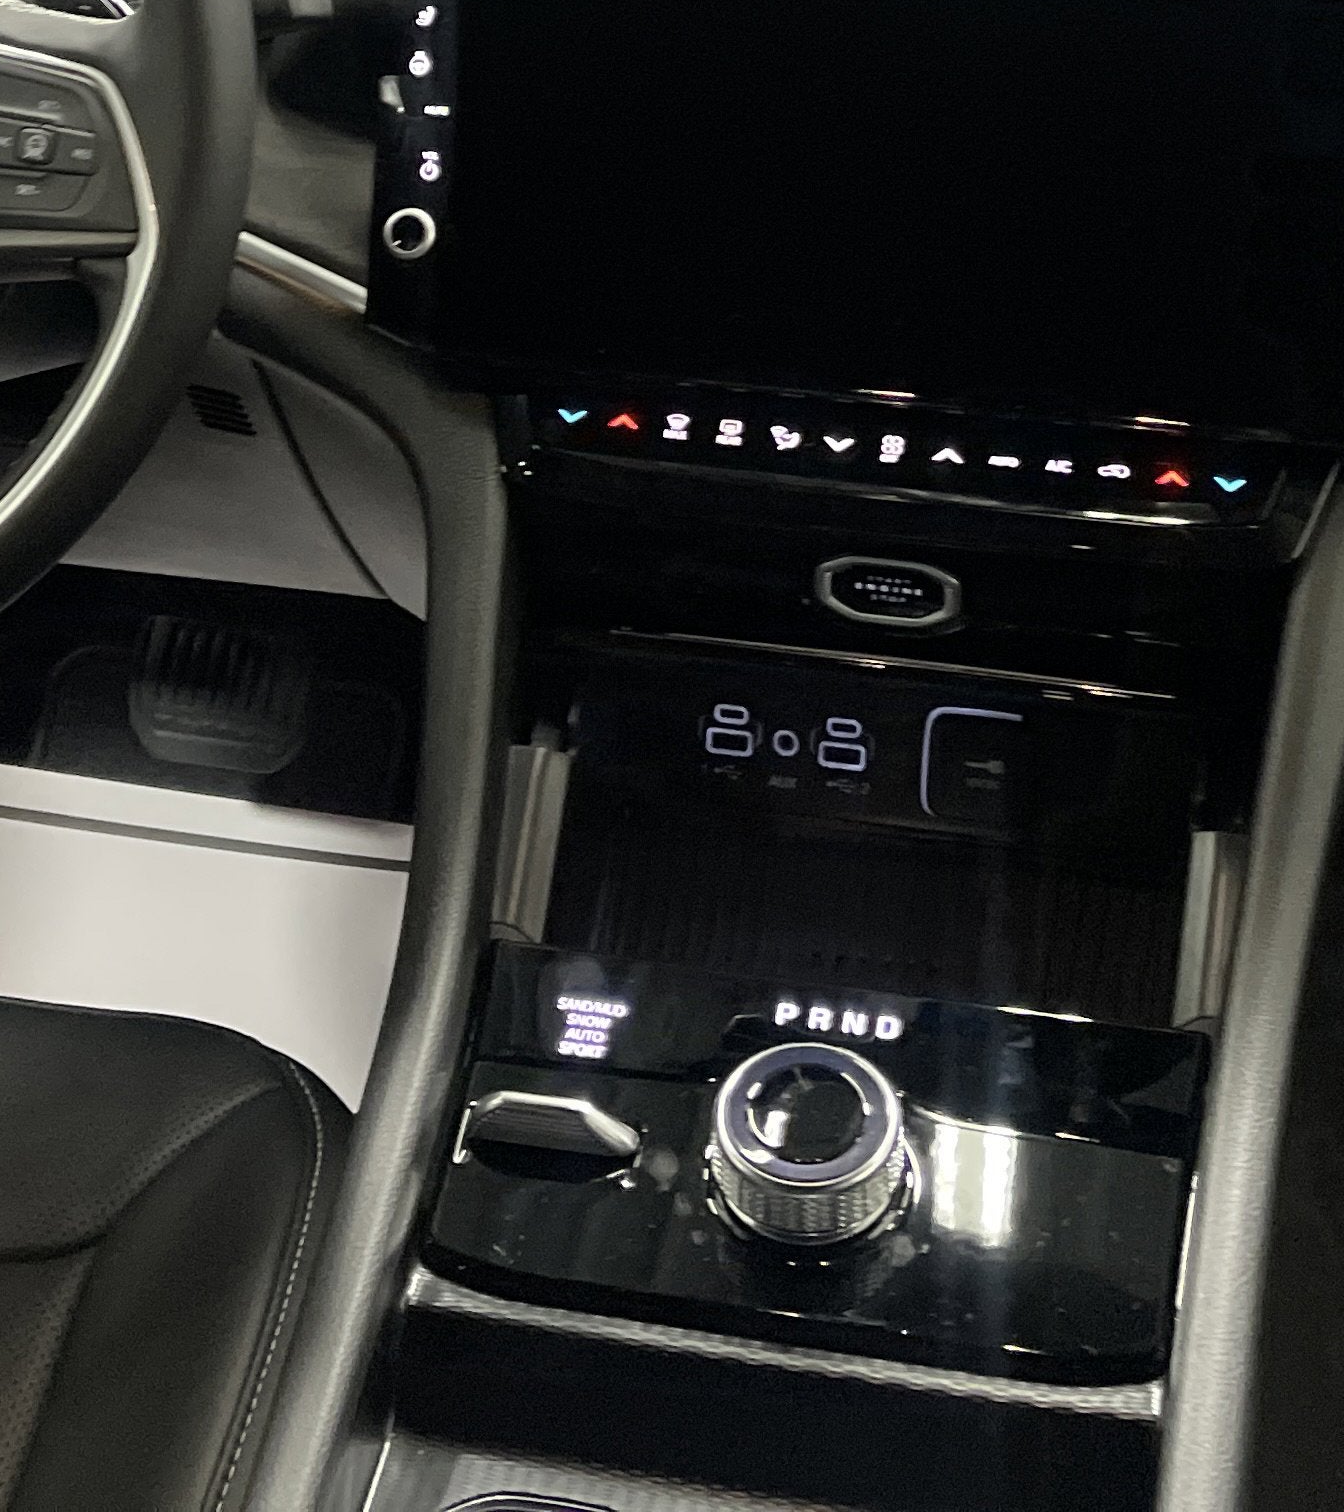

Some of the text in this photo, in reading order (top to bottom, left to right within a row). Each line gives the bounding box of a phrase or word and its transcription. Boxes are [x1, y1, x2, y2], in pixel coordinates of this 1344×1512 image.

[565, 1012, 613, 1030] SNOW
[563, 1027, 607, 1043] AUTO
[557, 1040, 609, 1059] SPORT
